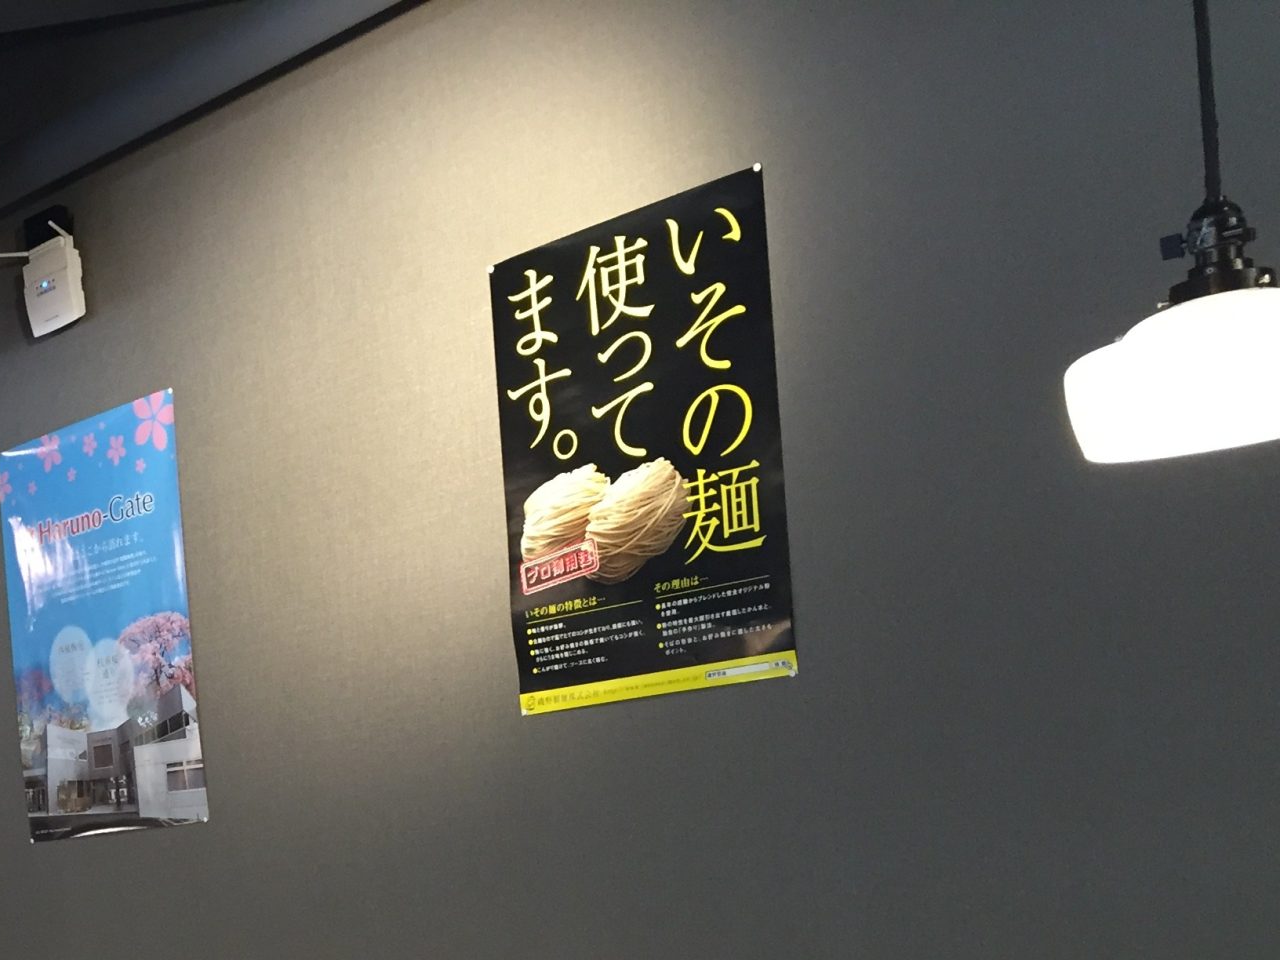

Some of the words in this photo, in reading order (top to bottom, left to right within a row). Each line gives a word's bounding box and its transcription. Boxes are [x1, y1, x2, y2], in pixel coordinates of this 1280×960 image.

[507, 269, 577, 460] ます。
[576, 235, 655, 457] 使って
[666, 208, 767, 565] いその麺
[38, 491, 155, 544] Haruno-Gate
